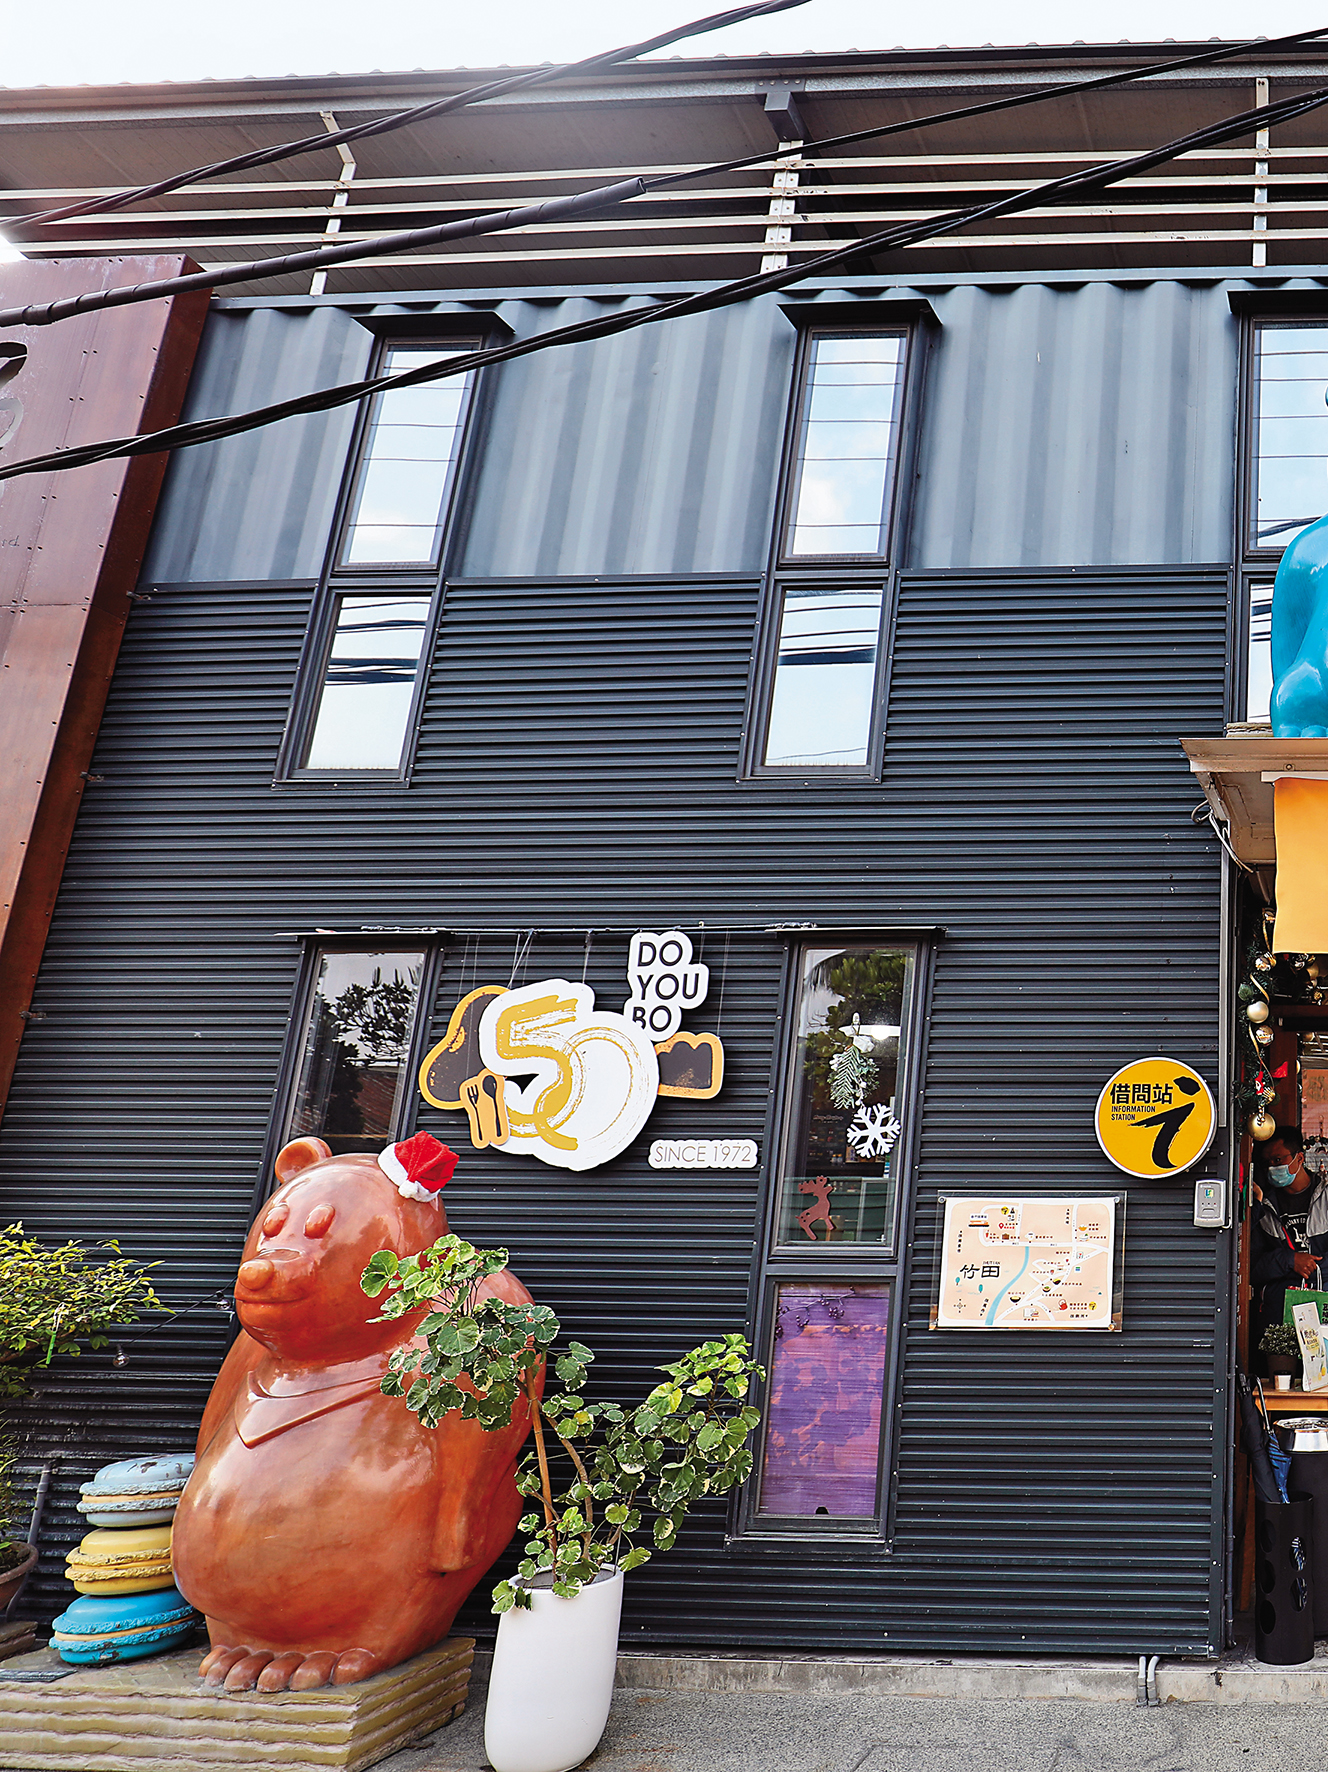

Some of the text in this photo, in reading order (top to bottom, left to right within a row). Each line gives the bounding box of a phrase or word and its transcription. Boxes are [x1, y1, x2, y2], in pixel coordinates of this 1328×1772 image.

[637, 941, 683, 967] DO
[637, 973, 700, 1001] YOU
[633, 1005, 672, 1031] BO
[1110, 1083, 1174, 1105] 借問站
[1111, 1105, 1156, 1113] INFORMATION
[1111, 1113, 1136, 1121] STATION
[654, 1145, 753, 1162] SINCE 1972
[959, 1264, 1001, 1280] 竹田
